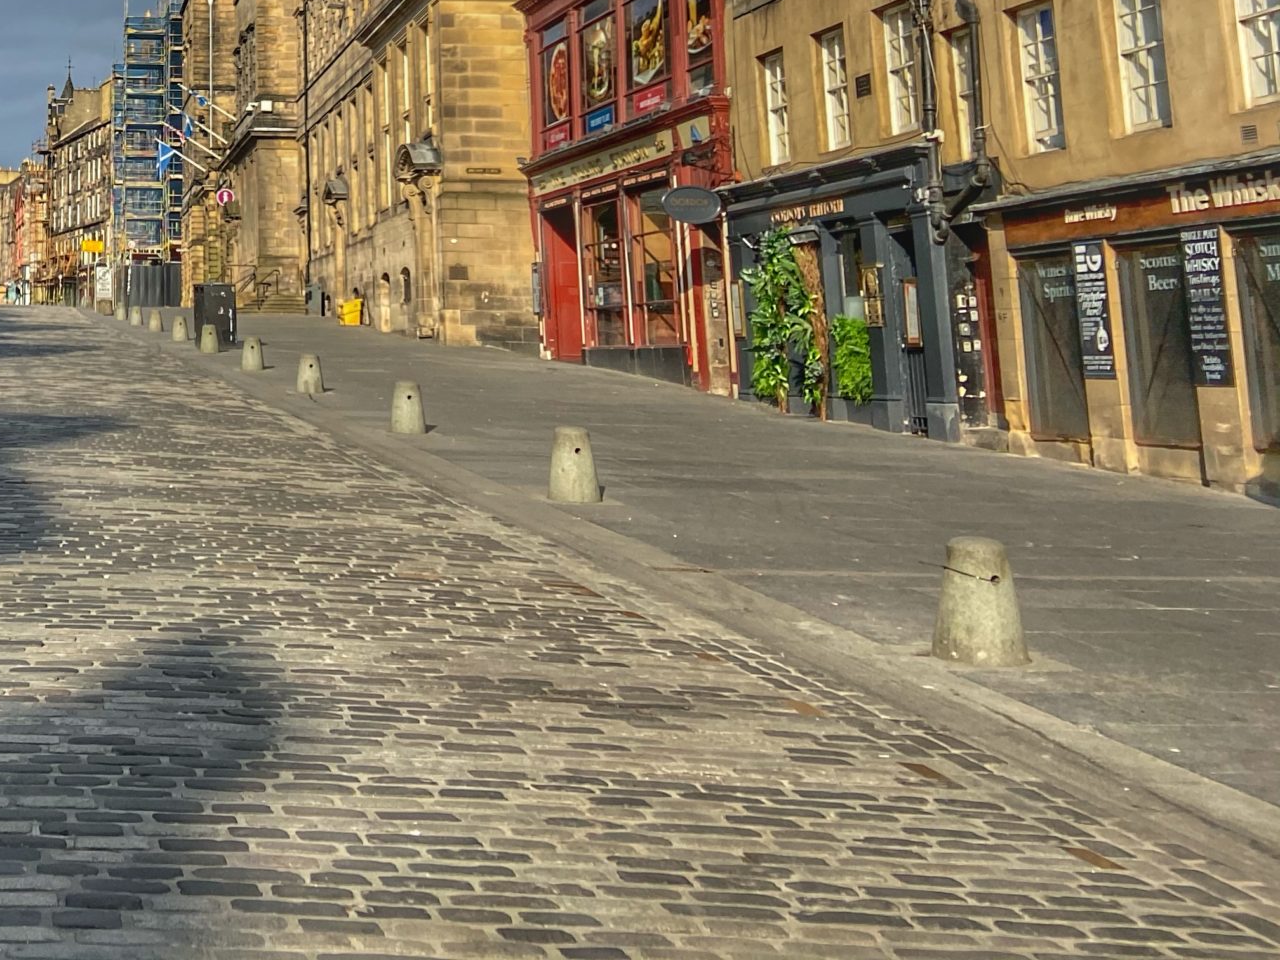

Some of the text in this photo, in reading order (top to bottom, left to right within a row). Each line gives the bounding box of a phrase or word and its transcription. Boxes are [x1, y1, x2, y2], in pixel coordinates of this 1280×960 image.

[1166, 181, 1210, 214] The
[1085, 203, 1117, 222] Whisky
[1180, 229, 1218, 242] SINGLE MALT
[1184, 241, 1218, 259] SCOTCH
[1184, 257, 1221, 273] WHISKY
[1187, 274, 1221, 287] Tastings
